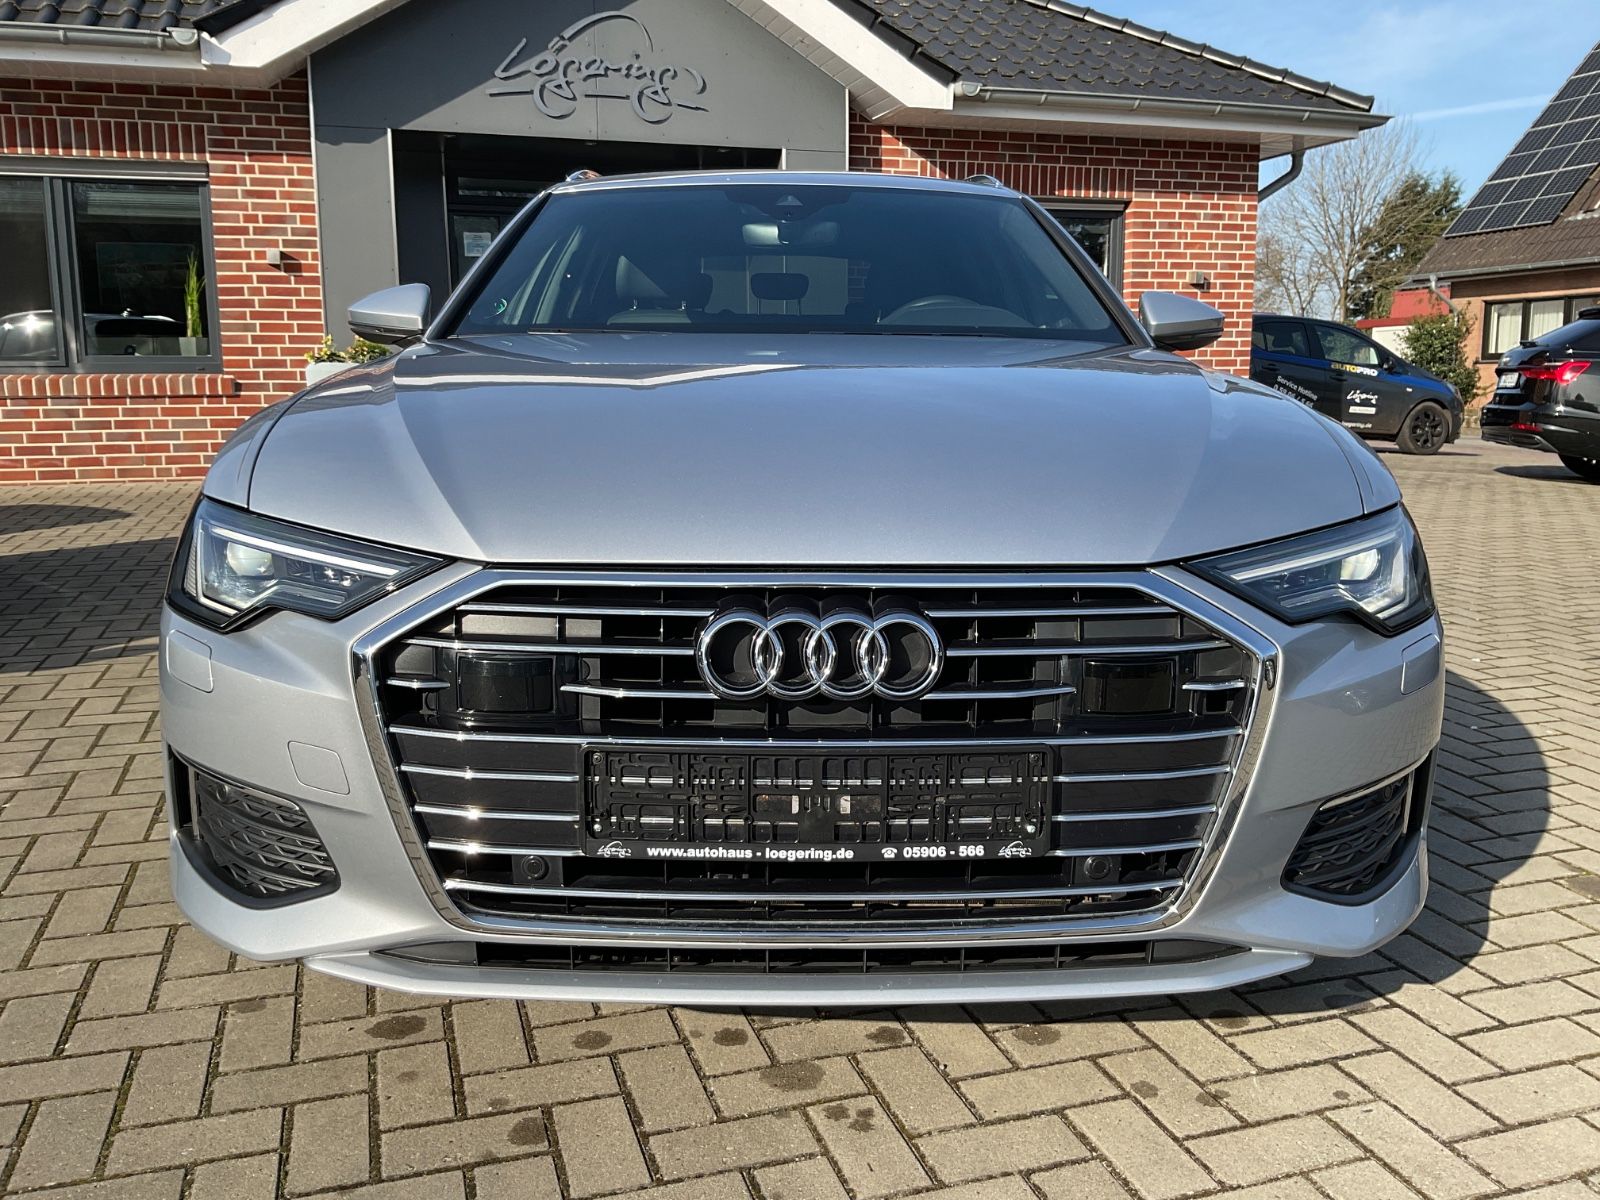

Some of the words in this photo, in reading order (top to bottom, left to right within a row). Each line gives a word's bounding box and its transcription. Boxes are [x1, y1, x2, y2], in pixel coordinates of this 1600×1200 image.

[1277, 375, 1298, 391] Service
[1297, 386, 1318, 401] Hotline
[647, 846, 753, 859] www.autohaus
[765, 848, 854, 861] loegering.de
[903, 846, 947, 858] 05906
[958, 845, 985, 857] 566
